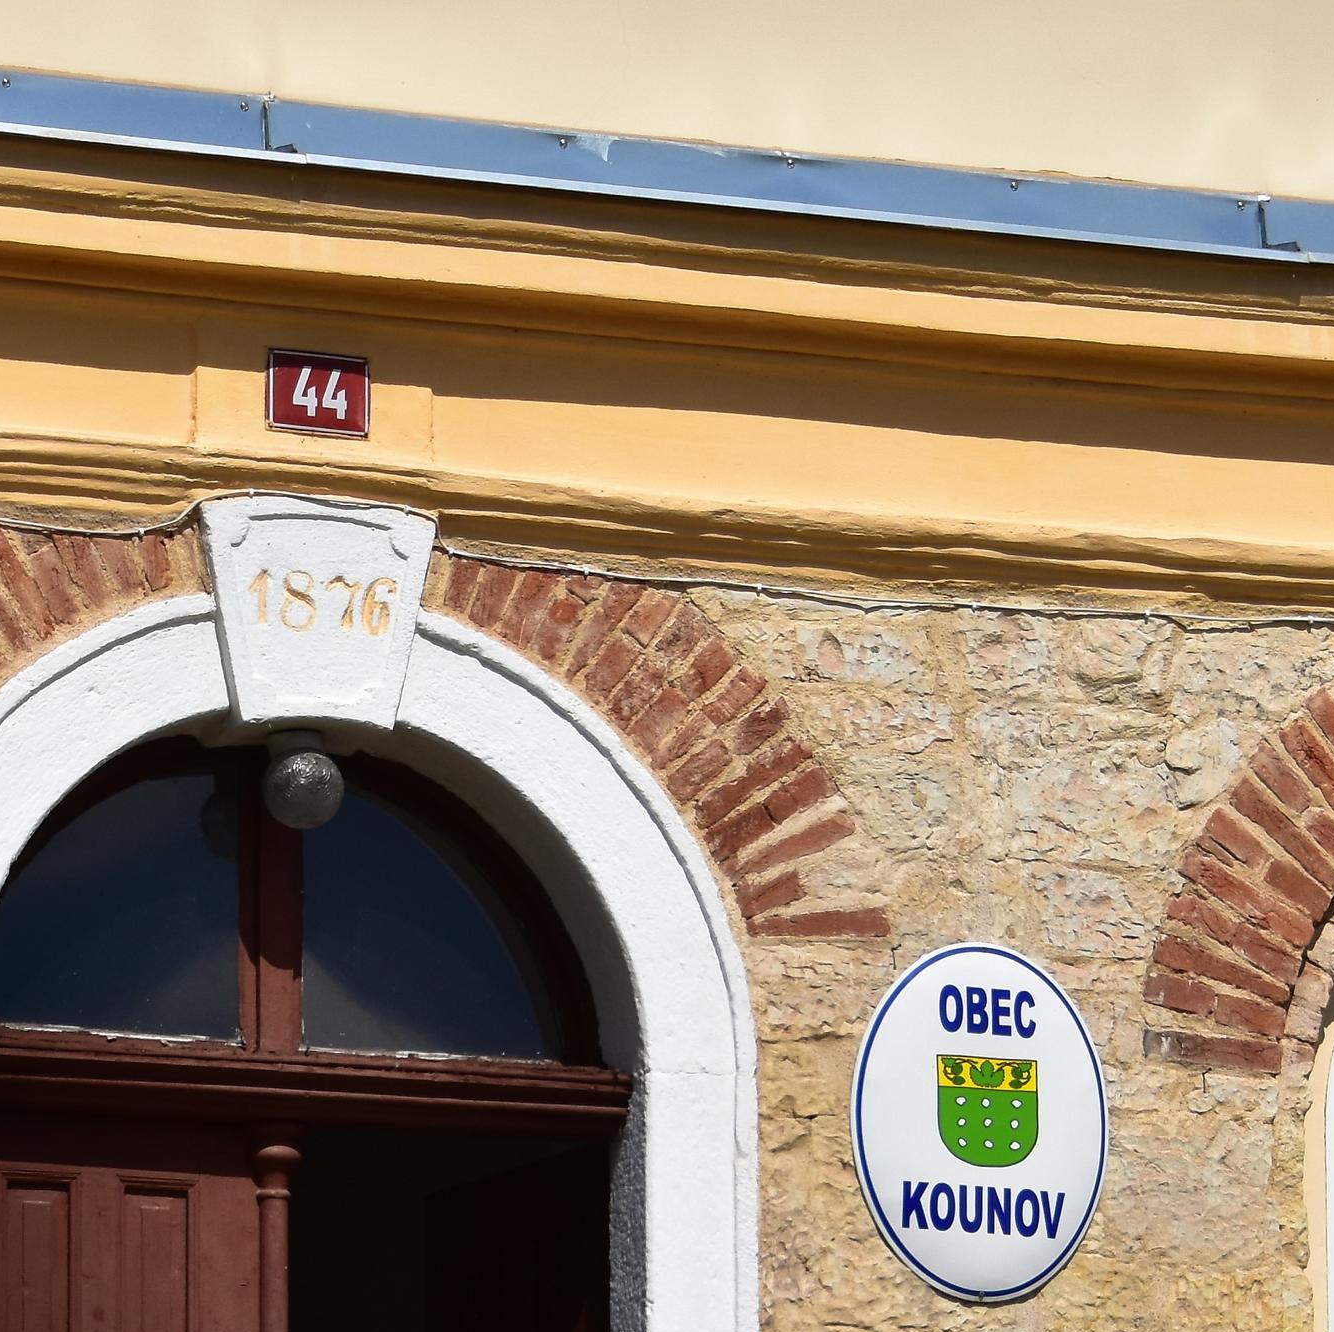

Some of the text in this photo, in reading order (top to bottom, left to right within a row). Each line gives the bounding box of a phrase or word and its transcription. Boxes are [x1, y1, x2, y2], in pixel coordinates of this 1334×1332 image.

[292, 365, 348, 420] 44
[247, 568, 397, 637] 1876
[938, 984, 1037, 1040] OBEC
[901, 1180, 1066, 1241] KOUNOV
